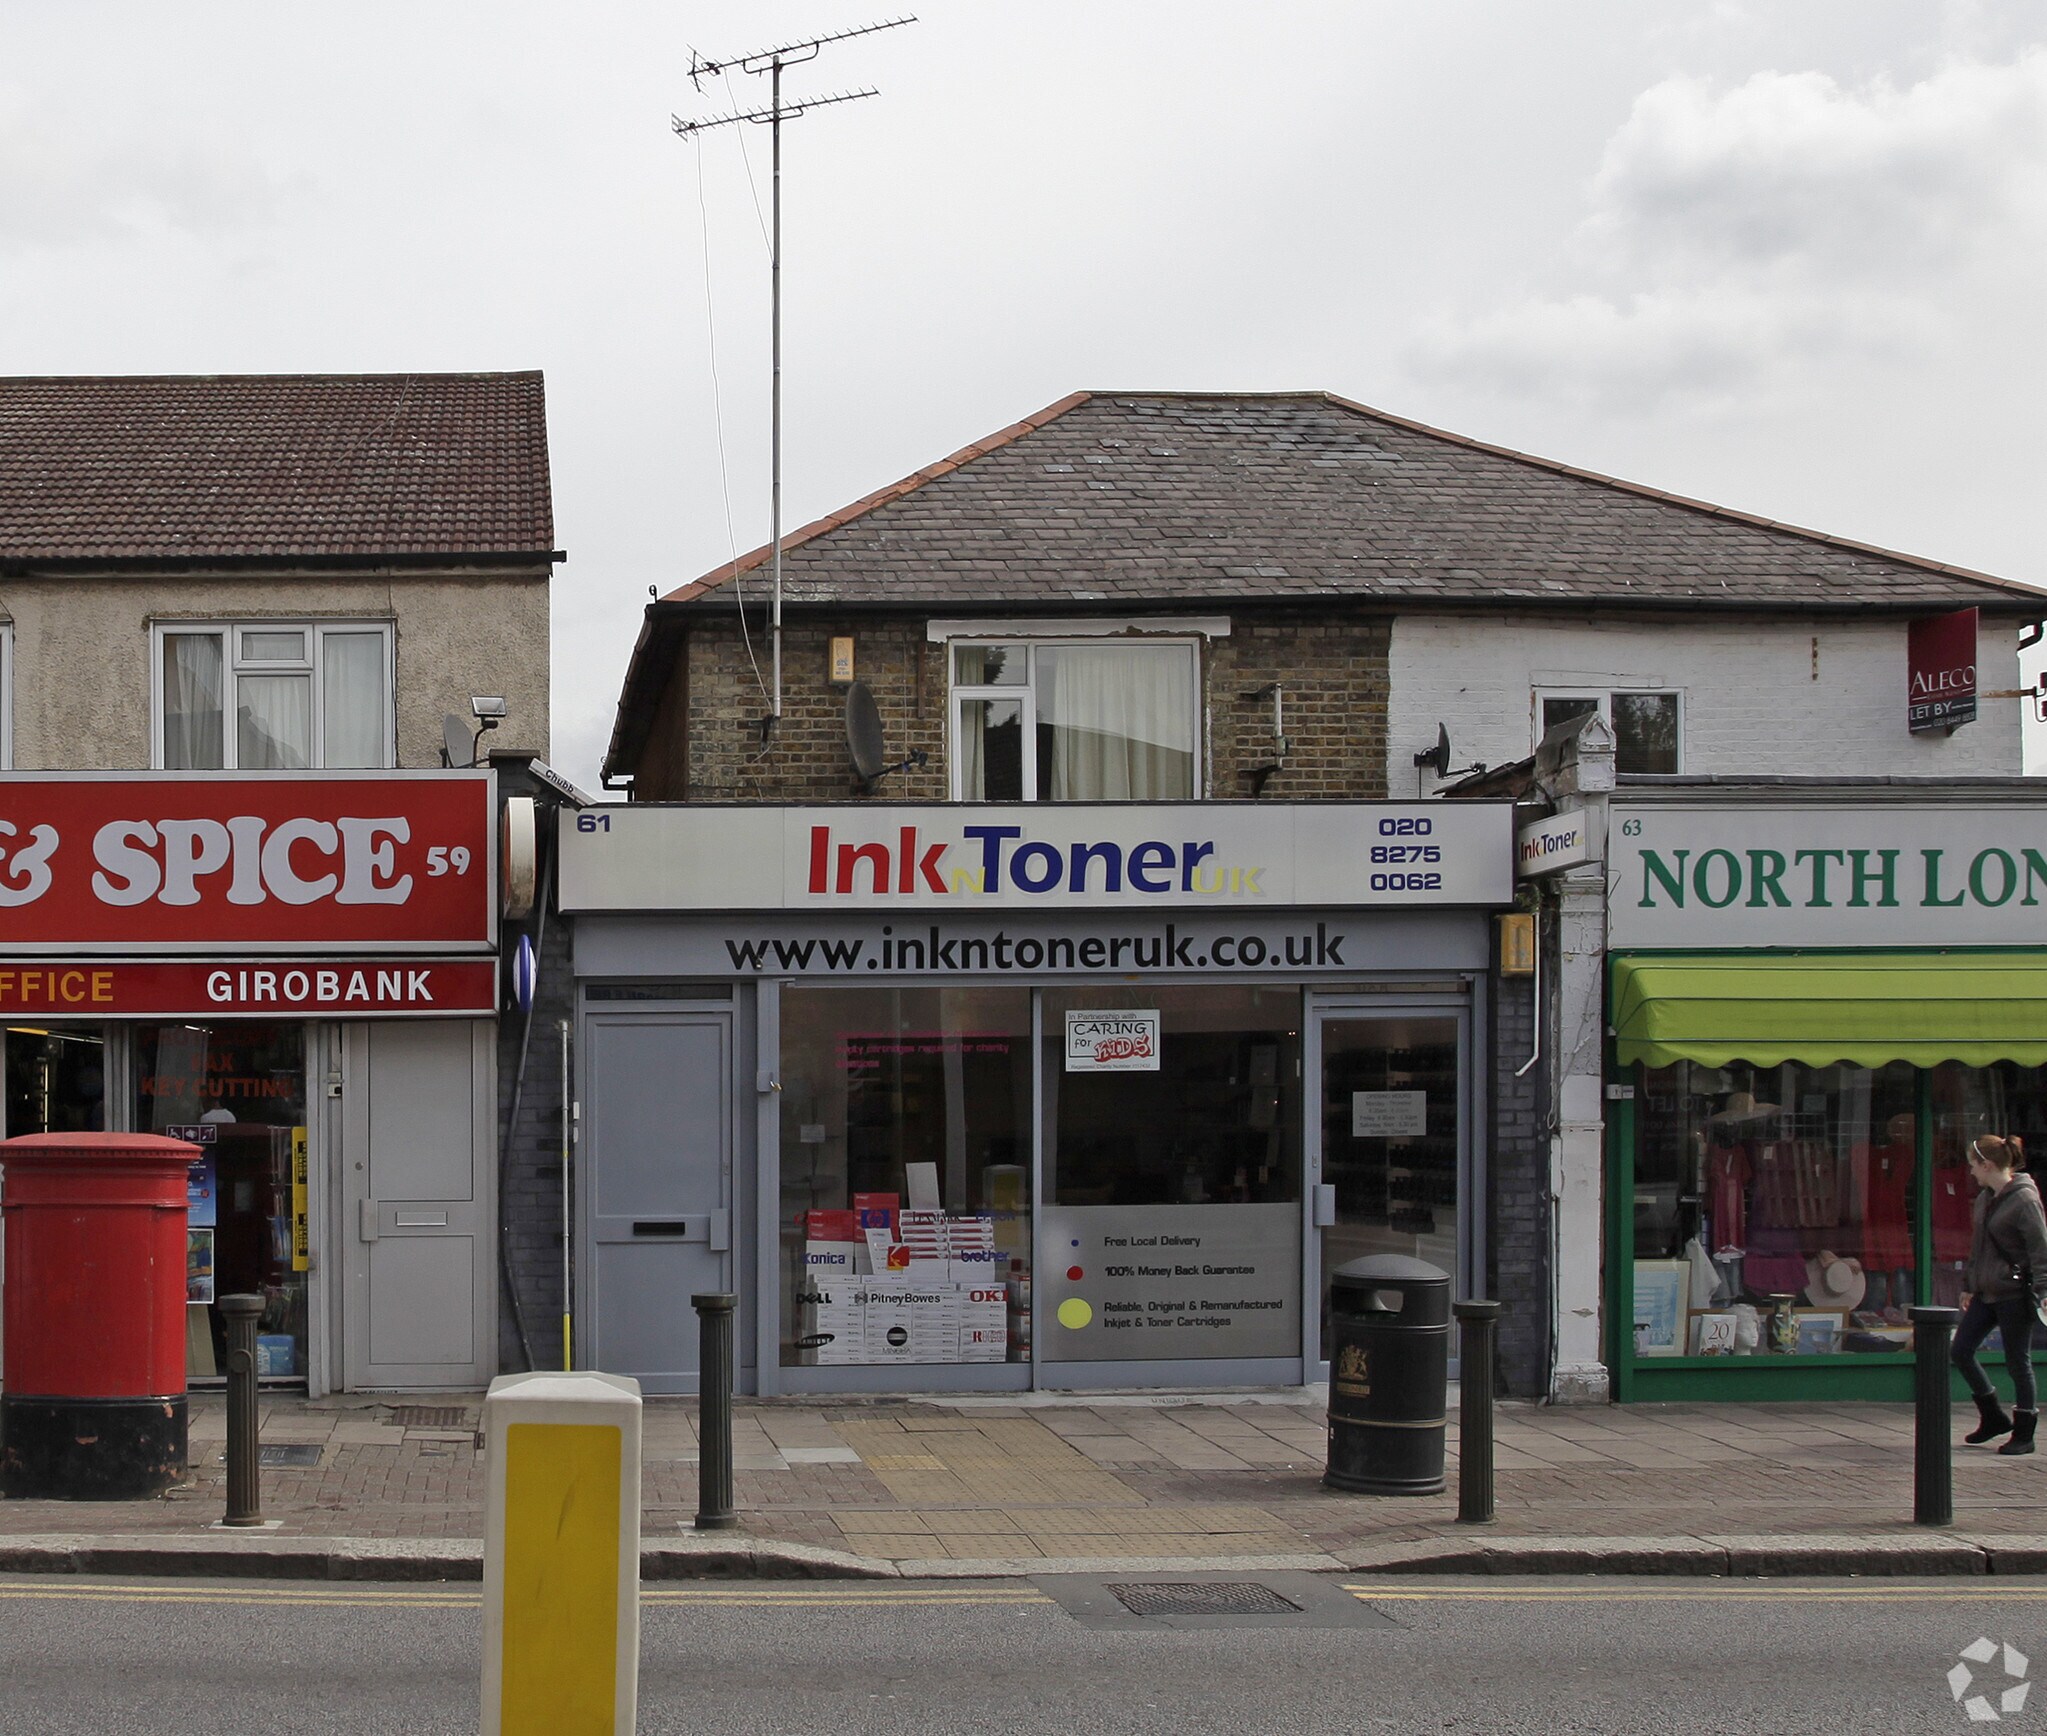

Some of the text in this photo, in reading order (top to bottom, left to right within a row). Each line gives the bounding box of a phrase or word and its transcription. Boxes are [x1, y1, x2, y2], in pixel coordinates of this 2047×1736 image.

[1910, 665, 1975, 695] ALECO
[1910, 701, 1952, 720] LET BY
[546, 770, 574, 793] Chubb
[576, 814, 611, 833] 61
[1378, 818, 1432, 836] 020
[1622, 819, 1642, 836] 63
[1370, 845, 1441, 864] 8275
[1520, 838, 1540, 862] Ink
[1541, 830, 1577, 855] Toner
[92, 816, 413, 906] SPICE
[426, 846, 471, 878] 59
[808, 826, 949, 894] Ink
[964, 826, 1214, 894] Toner
[1190, 866, 1262, 894] UK
[1370, 872, 1442, 891] 0062
[1638, 848, 1900, 909] NORTH
[724, 922, 1346, 971] www.inkntoneruk.co.uk
[0, 970, 114, 1002] FFICE
[207, 970, 434, 1002] GIROBANK
[1078, 1013, 1120, 1021] Partnership
[1074, 1022, 1147, 1036] CARING
[1075, 1038, 1092, 1048] for
[192, 1076, 295, 1098] CUTTING
[1104, 1236, 1200, 1248] Free Local Delivery
[801, 1250, 1009, 1264] Konica brother
[1105, 1264, 1255, 1278] 100% Money Back Guarantee
[796, 1293, 832, 1304] DELL
[970, 1290, 1008, 1302] OKI
[1104, 1300, 1282, 1314] Reliable, Original & Remanufactured
[1104, 1316, 1232, 1329] Inkjet & Toner Cartridges
[1708, 1322, 1730, 1340] 20
